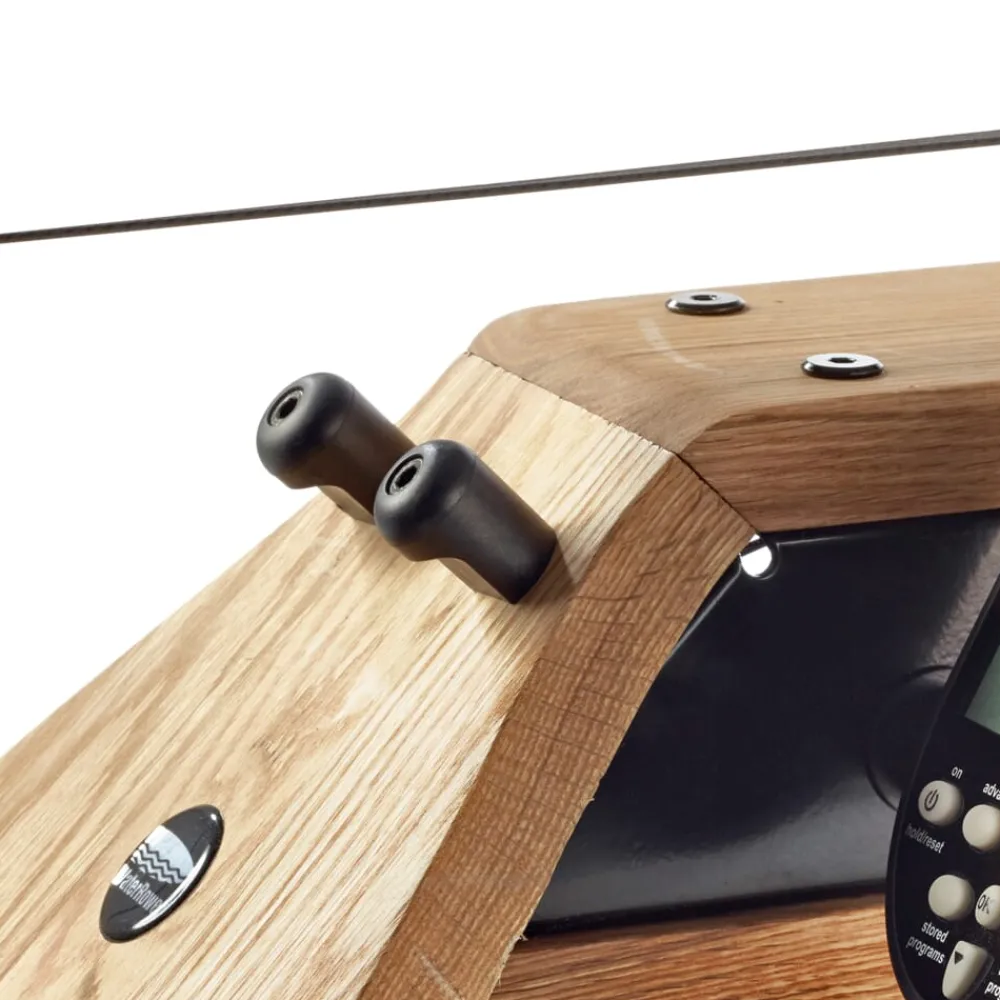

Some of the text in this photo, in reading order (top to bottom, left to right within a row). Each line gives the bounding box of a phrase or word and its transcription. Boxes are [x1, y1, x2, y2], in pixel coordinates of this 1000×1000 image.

[951, 765, 963, 779] on
[905, 822, 946, 854] hold/reset
[977, 894, 993, 915] OK
[921, 920, 949, 944] stored
[906, 934, 946, 965] programs
